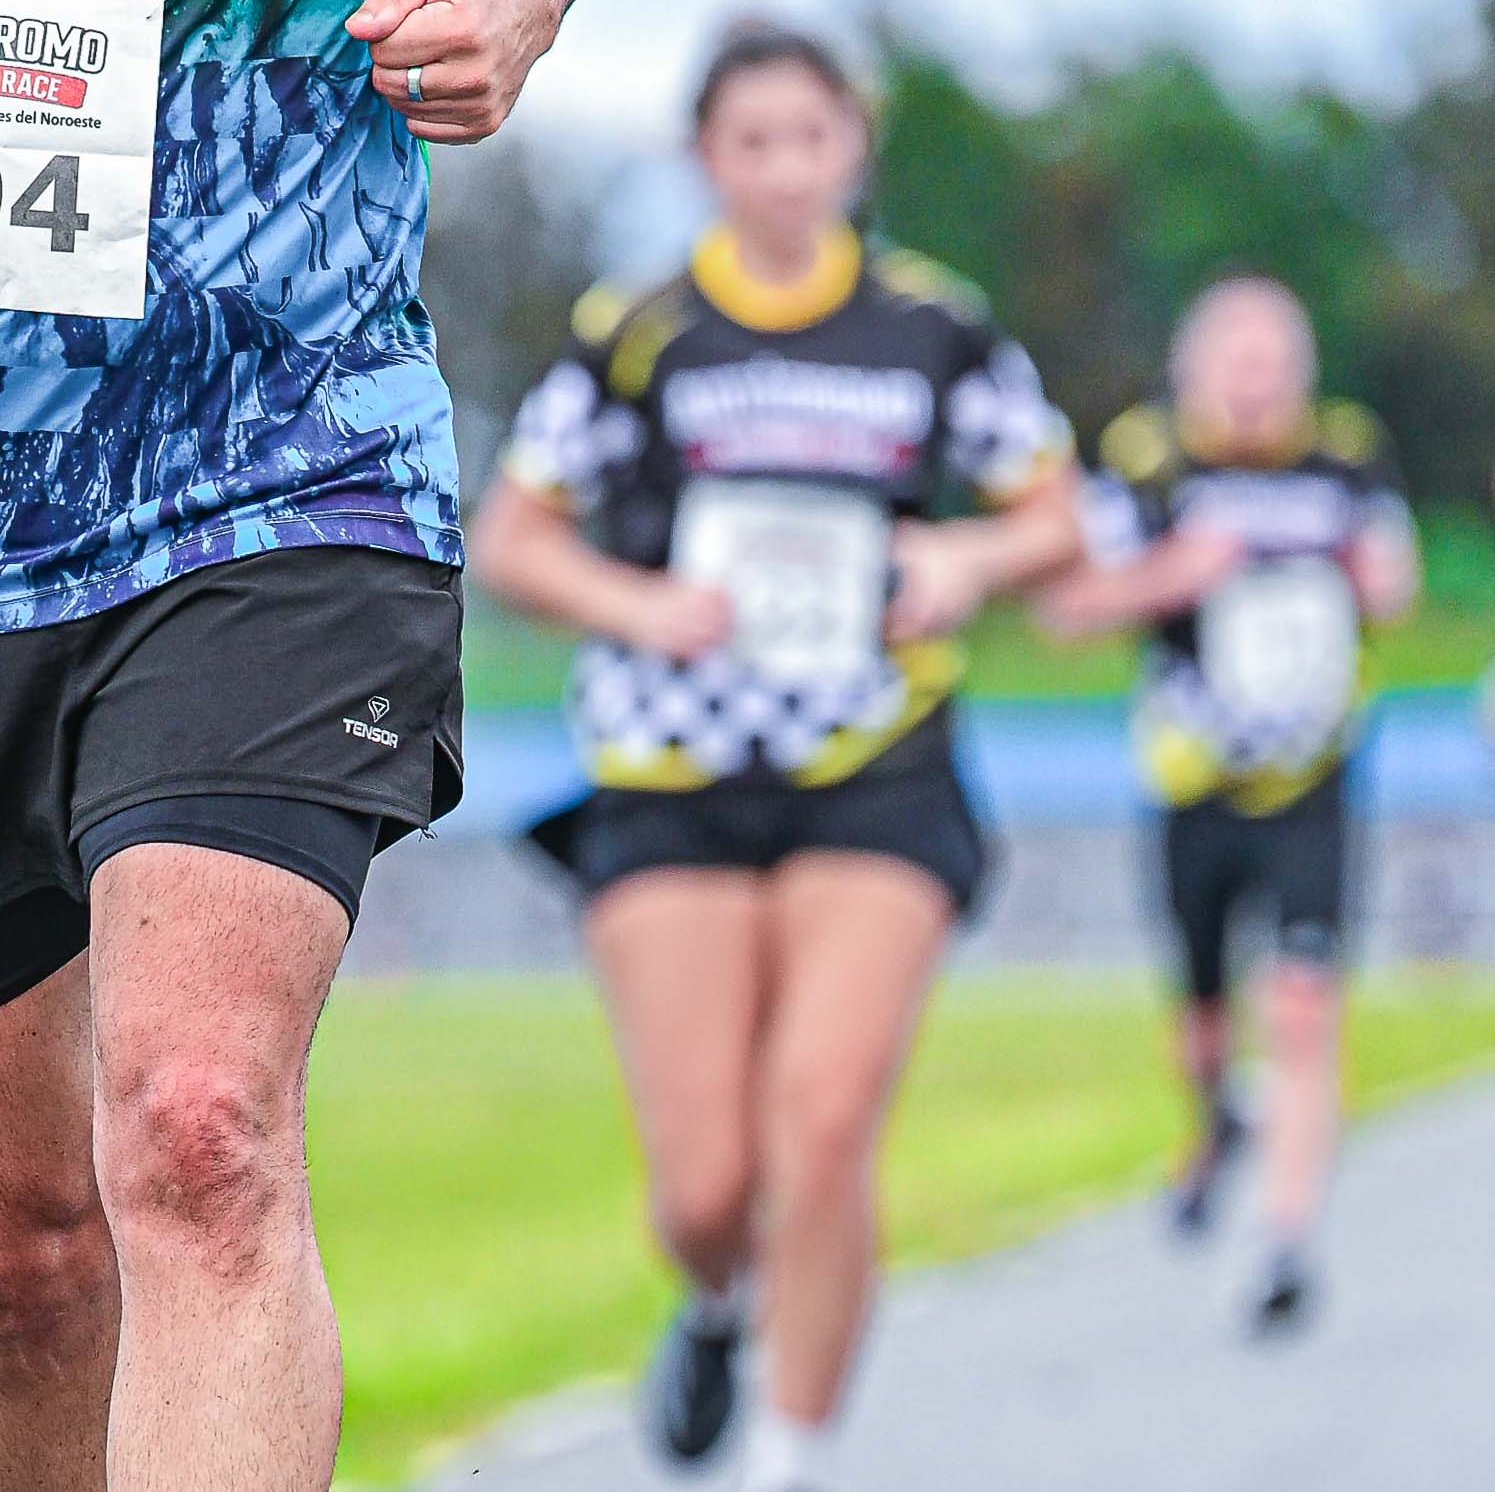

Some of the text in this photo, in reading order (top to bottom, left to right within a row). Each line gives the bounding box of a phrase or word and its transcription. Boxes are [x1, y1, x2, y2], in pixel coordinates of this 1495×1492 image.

[1, 69, 62, 102] RACE
[15, 110, 37, 124] del
[40, 112, 102, 129] Noroeste
[342, 717, 399, 749] TENSOR
